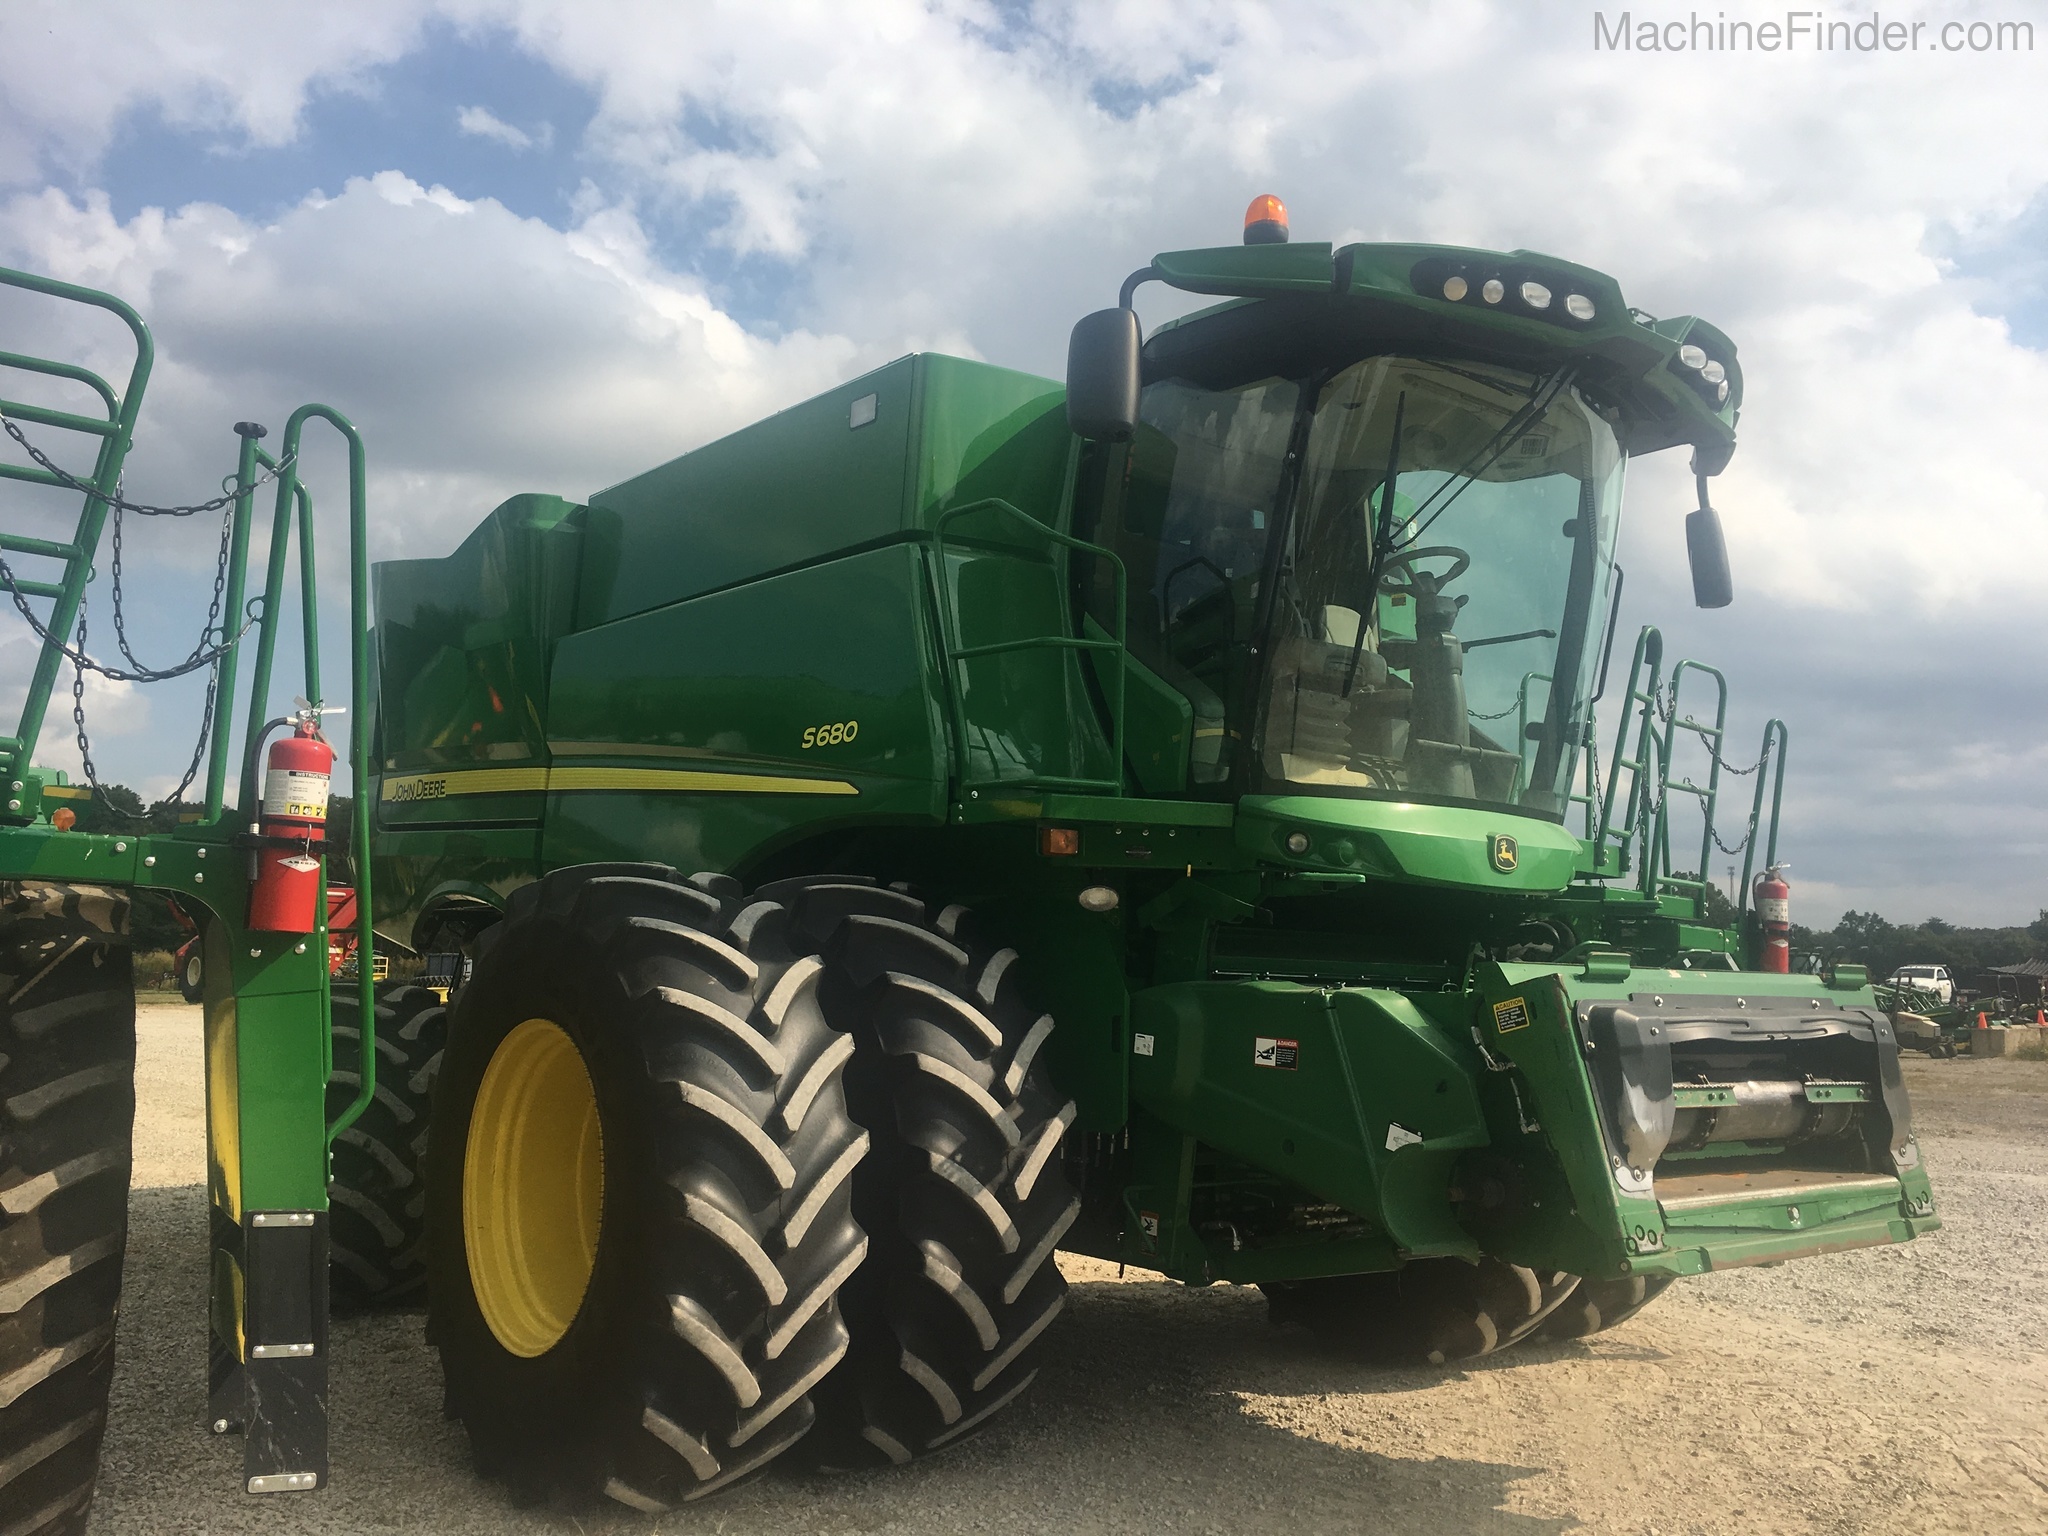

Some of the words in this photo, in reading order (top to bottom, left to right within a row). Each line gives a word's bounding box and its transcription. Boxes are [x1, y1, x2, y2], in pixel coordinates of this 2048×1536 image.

[801, 720, 859, 749] S680
[391, 781, 416, 801] JOHN
[416, 779, 446, 798] DEERE
[1499, 998, 1523, 1009] CAUTION
